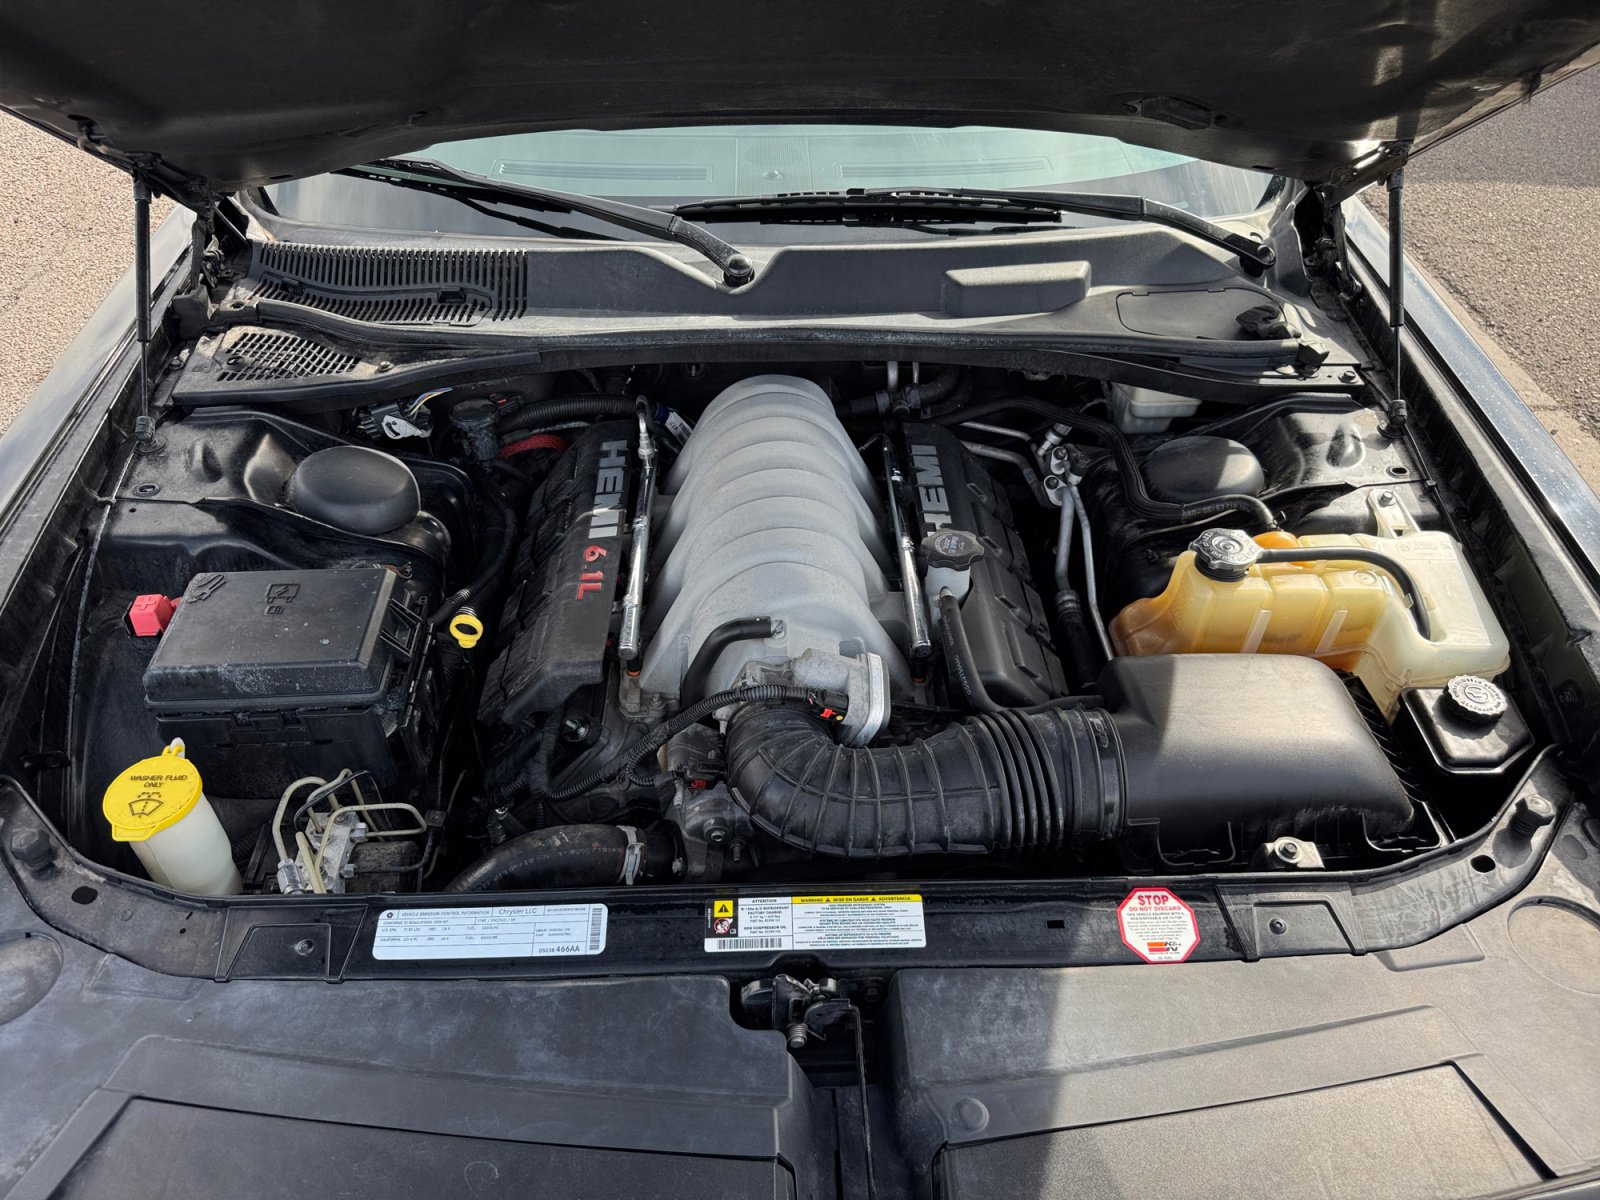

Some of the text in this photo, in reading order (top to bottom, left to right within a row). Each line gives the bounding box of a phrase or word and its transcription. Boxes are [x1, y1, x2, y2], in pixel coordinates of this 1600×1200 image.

[588, 440, 628, 538] HEMI
[576, 545, 607, 600] 6.1L
[1138, 895, 1168, 905] STOP
